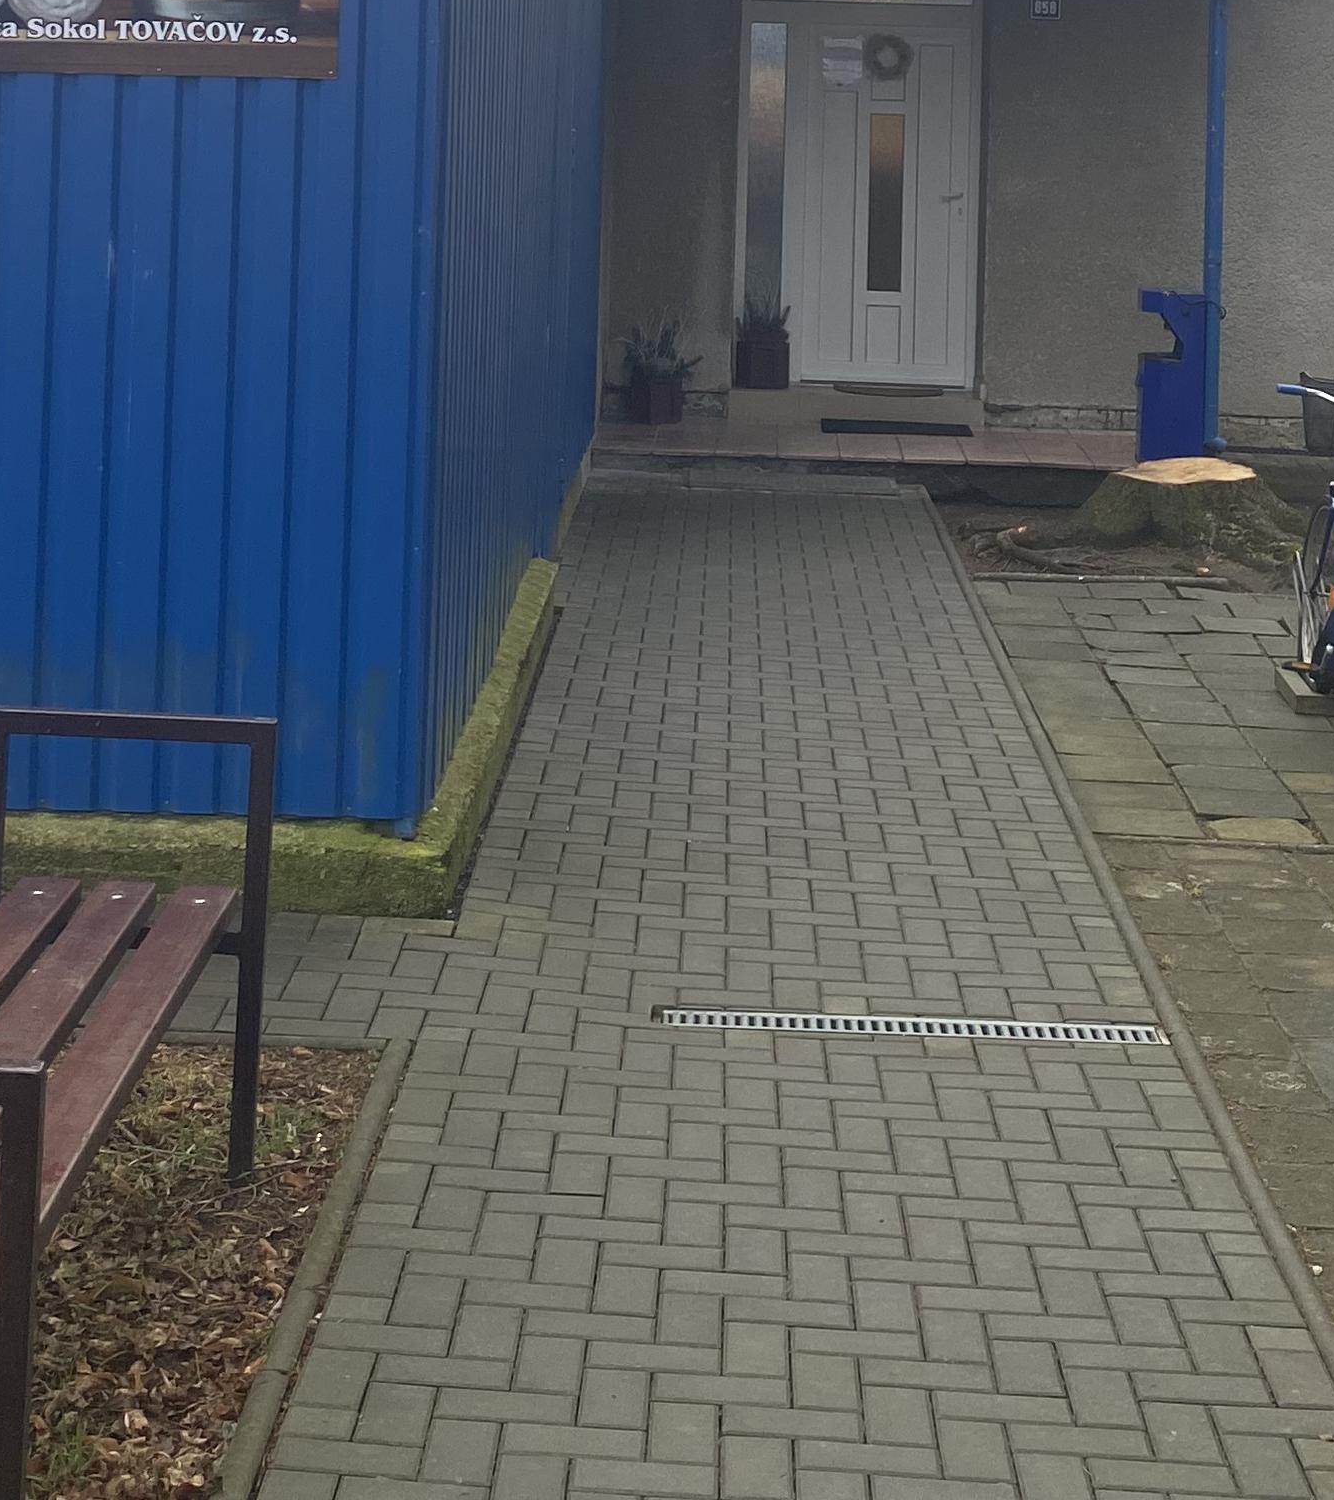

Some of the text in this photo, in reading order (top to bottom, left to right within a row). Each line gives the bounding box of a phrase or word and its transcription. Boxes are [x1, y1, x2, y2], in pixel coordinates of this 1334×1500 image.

[26, 18, 106, 40] Sokol
[114, 14, 245, 42] TOVAČOV
[251, 26, 298, 44] z.s.
